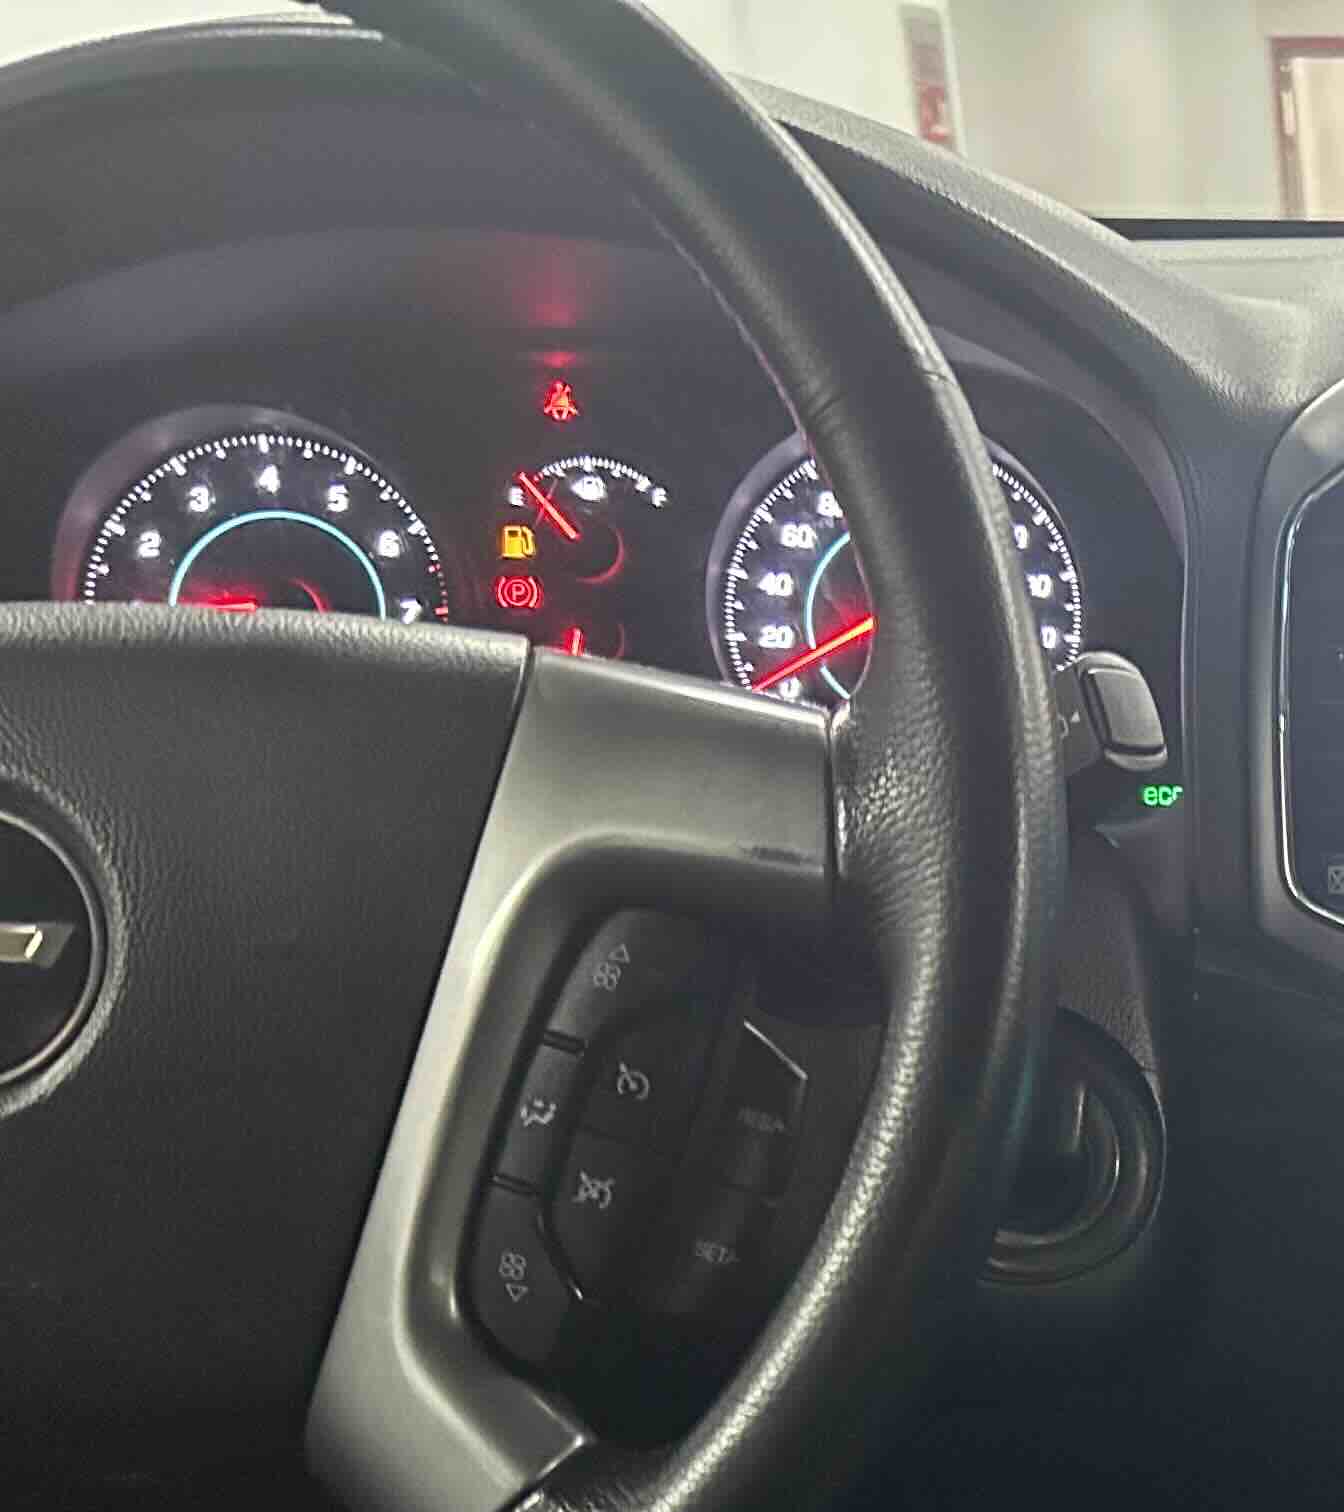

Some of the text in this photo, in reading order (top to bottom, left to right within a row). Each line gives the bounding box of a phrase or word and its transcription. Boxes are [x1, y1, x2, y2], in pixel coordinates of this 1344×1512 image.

[259, 464, 280, 494] 4
[188, 484, 211, 513] 3
[326, 484, 349, 513] 5
[137, 529, 161, 558] 2
[377, 529, 400, 558] 6
[781, 523, 816, 549] 60
[757, 571, 794, 597] 40
[758, 625, 795, 648] 20
